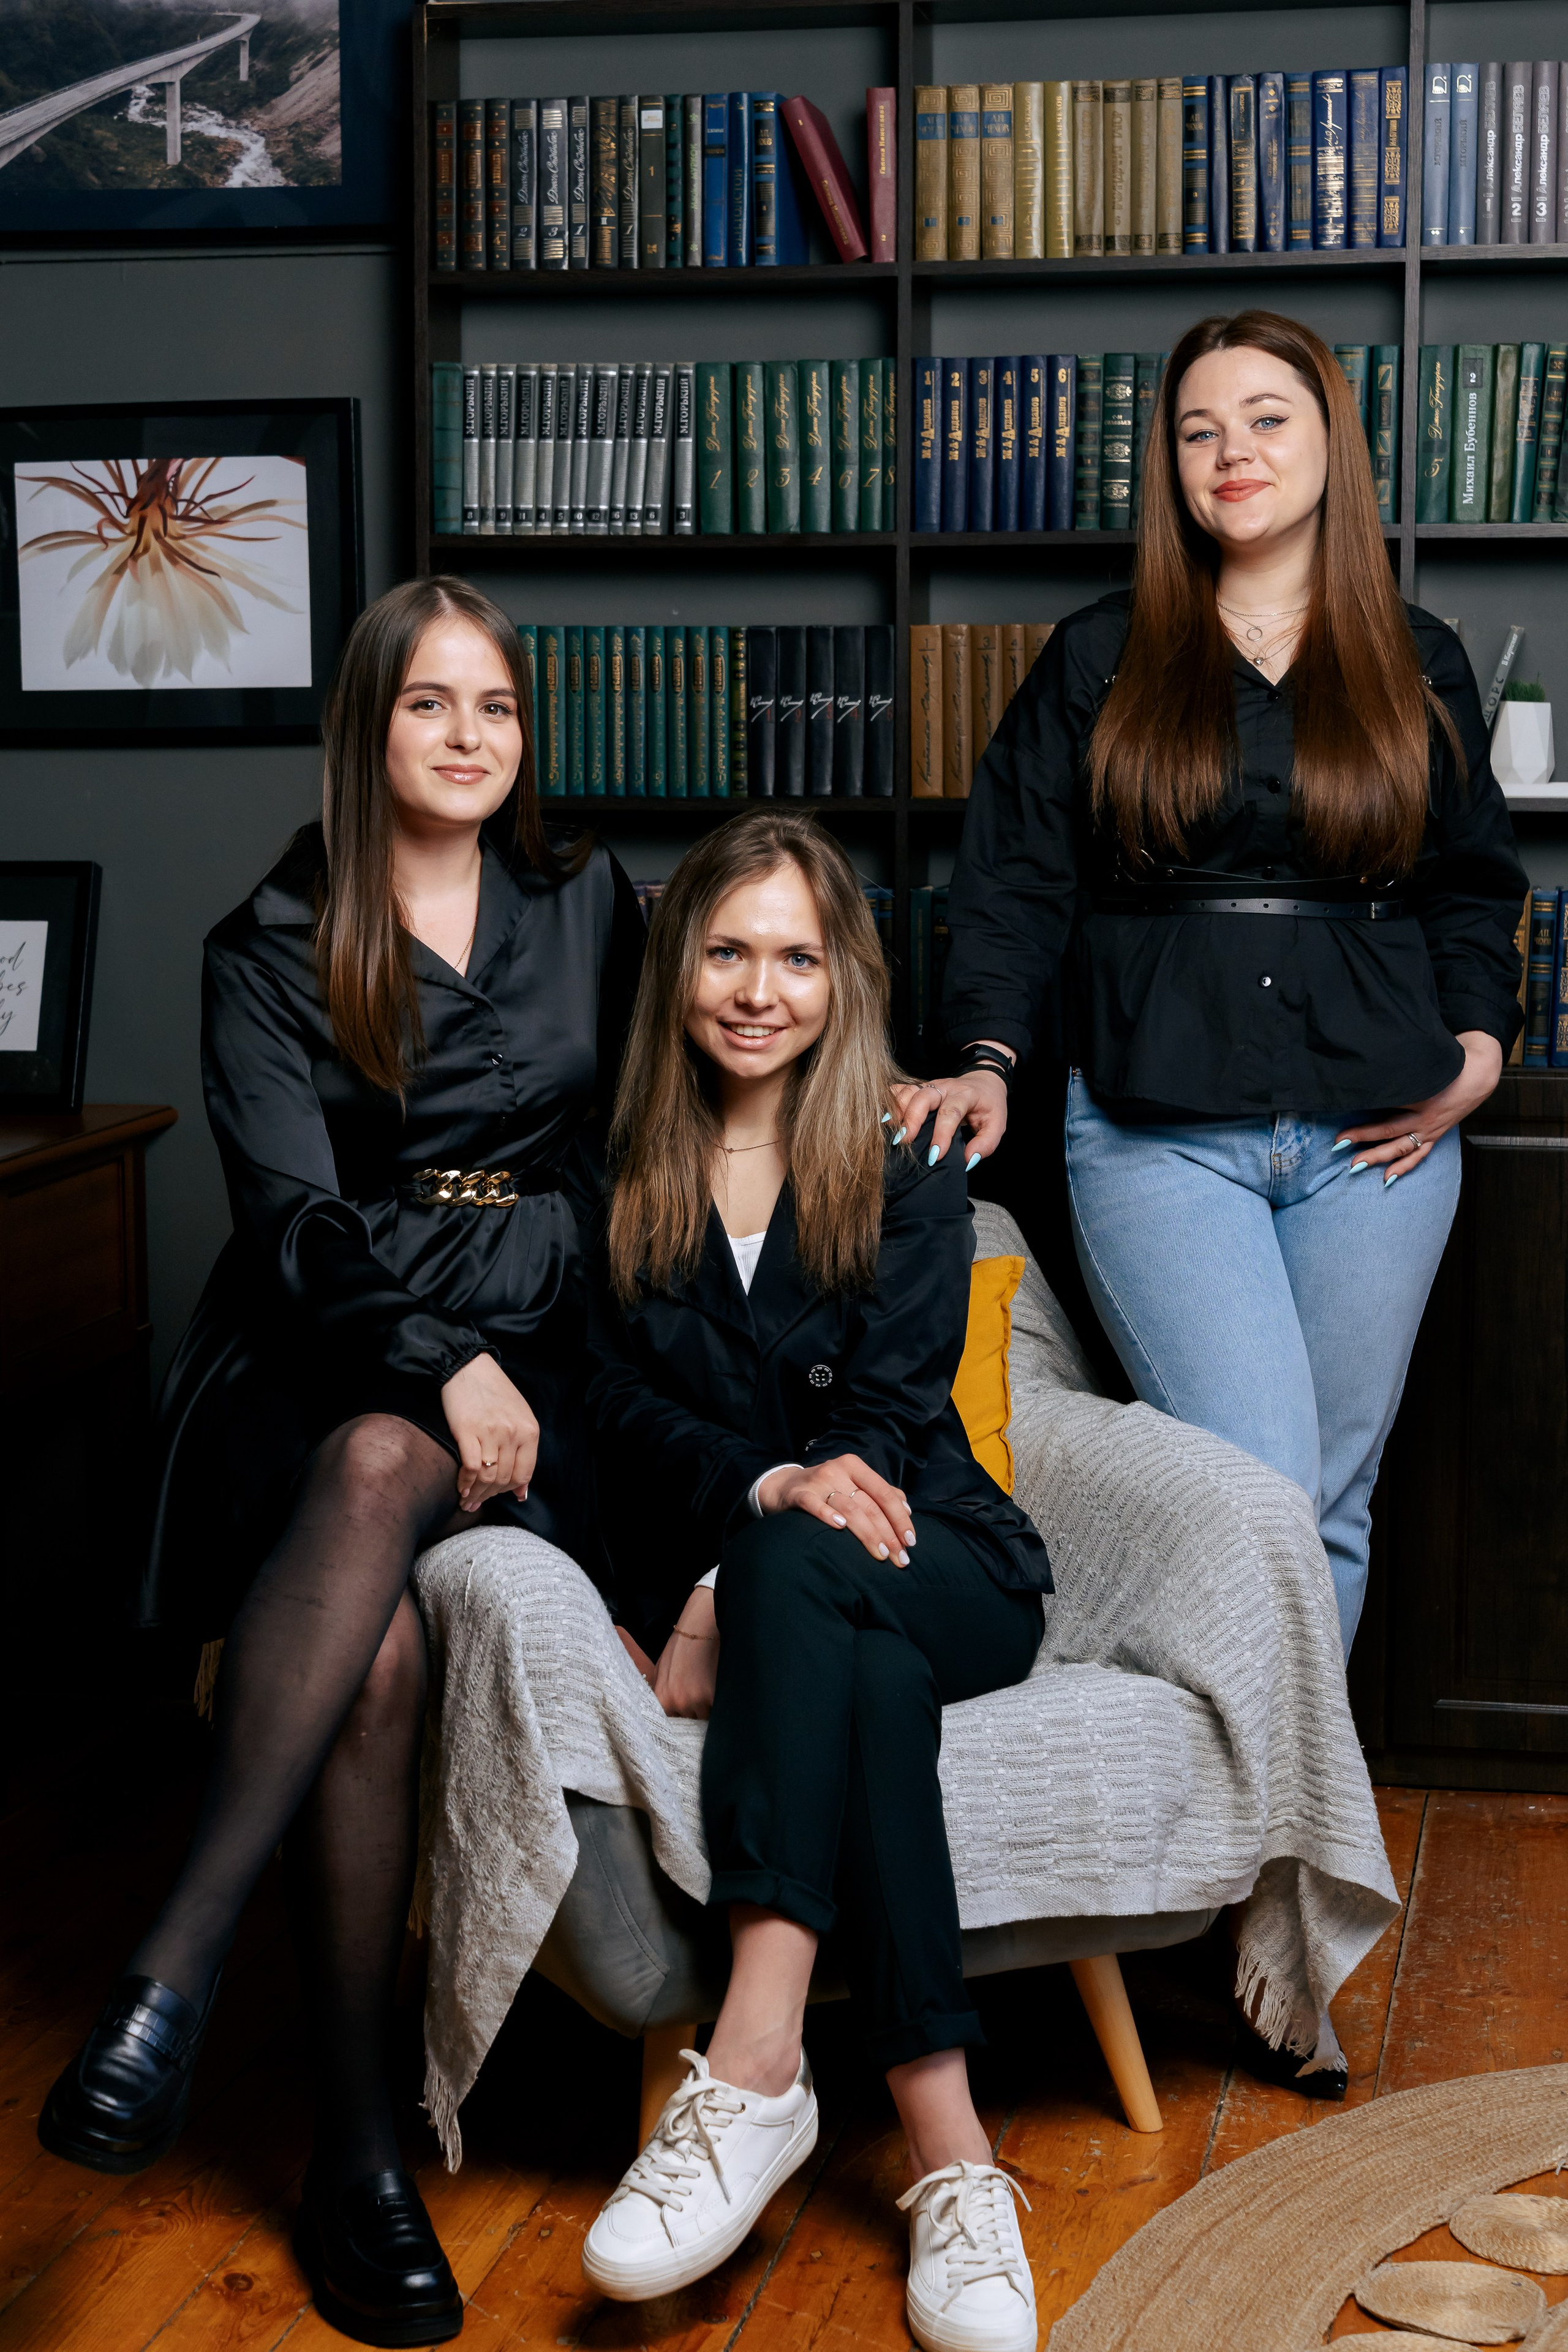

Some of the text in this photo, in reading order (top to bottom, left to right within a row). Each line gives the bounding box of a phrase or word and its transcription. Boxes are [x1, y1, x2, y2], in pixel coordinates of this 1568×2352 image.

[1511, 85, 1525, 193] Александр БЕЛЯЕВ
[1536, 85, 1550, 194] Александр БЕЛЯЕВ
[1484, 129, 1496, 189] Александр
[649, 166, 654, 176] 1
[547, 173, 559, 204] Джон
[573, 172, 585, 202] Джон
[518, 227, 527, 236] 2
[548, 227, 558, 236] 3
[575, 225, 583, 235] 1
[625, 225, 633, 235] 1
[924, 371, 931, 385] 1
[951, 372, 960, 386] 2
[979, 370, 987, 385] 3
[1003, 371, 1012, 385] 4
[1030, 368, 1039, 383] 5
[1057, 368, 1066, 383] 6
[1469, 372, 1476, 383] 2
[466, 379, 475, 434] М.ГОРЬКИЙ
[483, 379, 492, 435] М.ГОРЬКИЙ
[500, 379, 509, 435] М.ГОРЬКИЙ
[521, 379, 530, 435] М.ГОРЬКИЙ
[541, 379, 552, 435] М.ГОРЬКИЙ
[559, 380, 570, 436] М.ГОРЬКИЙ
[578, 379, 589, 435] М.ГОРЬКИЙ
[597, 379, 608, 435] М.ГОРЬКИЙ
[618, 378, 630, 434] М.ГОРЬКИЙ
[635, 379, 647, 435] М.ГОРЬКИЙ
[653, 379, 665, 434] М.ГОРЬКИЙ
[680, 378, 688, 434] М.ГОРЬКИЙ
[807, 371, 823, 447] Джон Голсуорси
[1428, 361, 1446, 440] Джон Голсуорси
[1462, 392, 1477, 505] Михаил Бубеннов
[775, 468, 790, 488] 3
[807, 466, 823, 486] 4
[862, 468, 880, 488] 7
[884, 466, 895, 486] 8
[1424, 458, 1444, 478] 5
[707, 470, 722, 489] 1
[744, 469, 759, 488] 2
[839, 470, 853, 489] 6
[982, 636, 990, 647] 3
[1036, 638, 1044, 647] 5
[850, 707, 860, 720] 4
